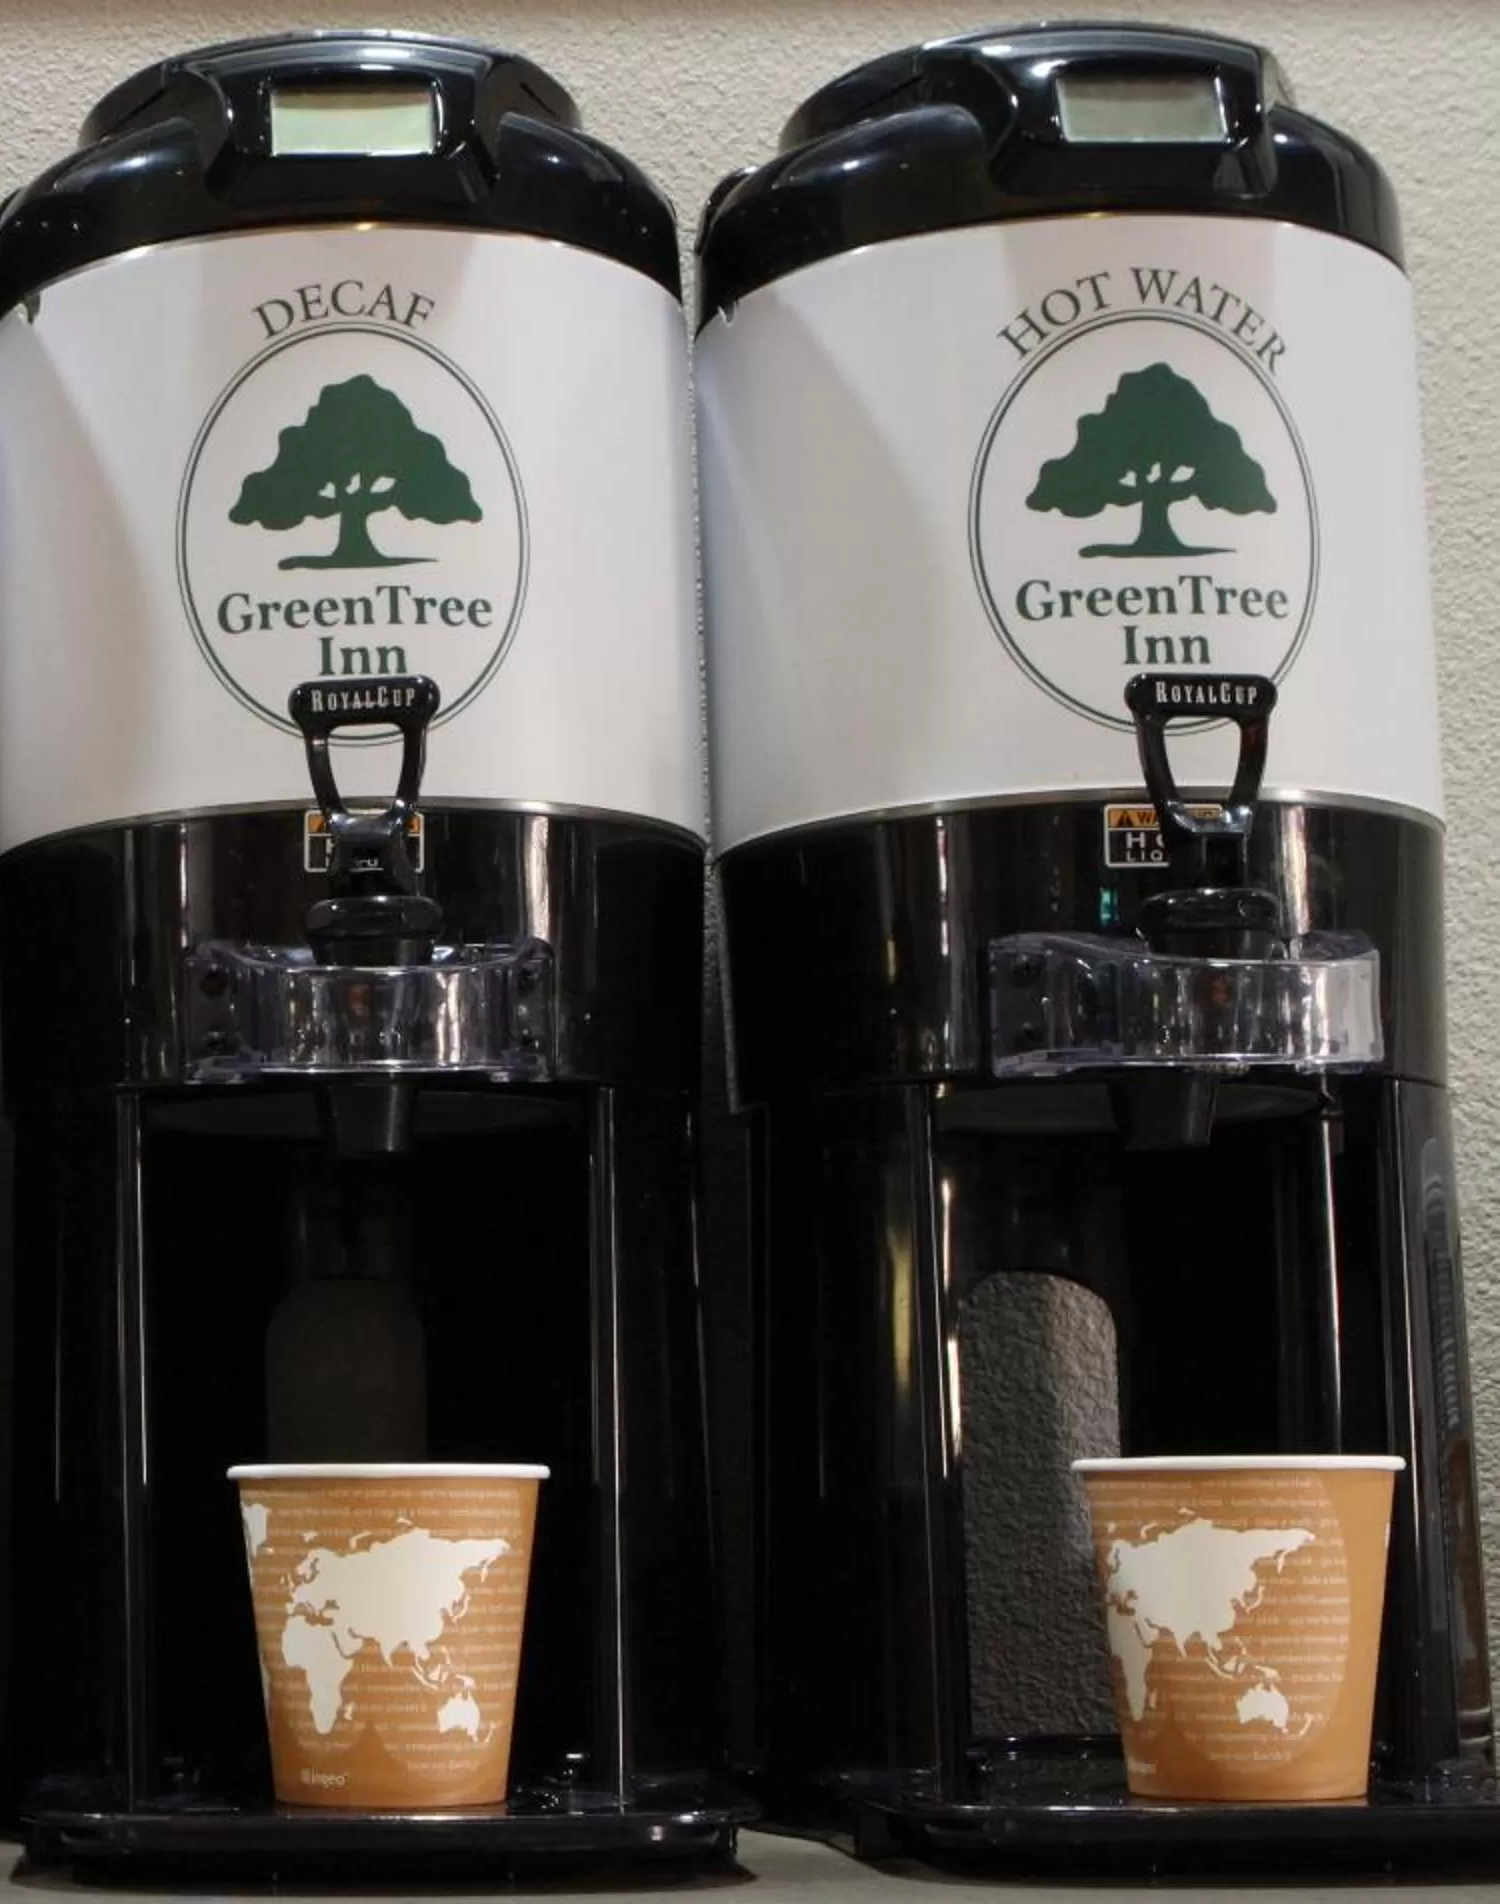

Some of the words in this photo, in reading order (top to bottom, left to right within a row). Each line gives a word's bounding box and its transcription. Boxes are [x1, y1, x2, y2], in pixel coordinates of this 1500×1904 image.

[252, 279, 436, 341] DECAF
[996, 271, 1112, 360] HOT
[1129, 266, 1286, 375] WATER
[217, 585, 493, 634] GreenTree
[1015, 575, 1290, 621] GreenTree
[317, 636, 409, 676] Inn
[1121, 625, 1212, 665] Inn
[1126, 849, 1164, 862] LIQ
